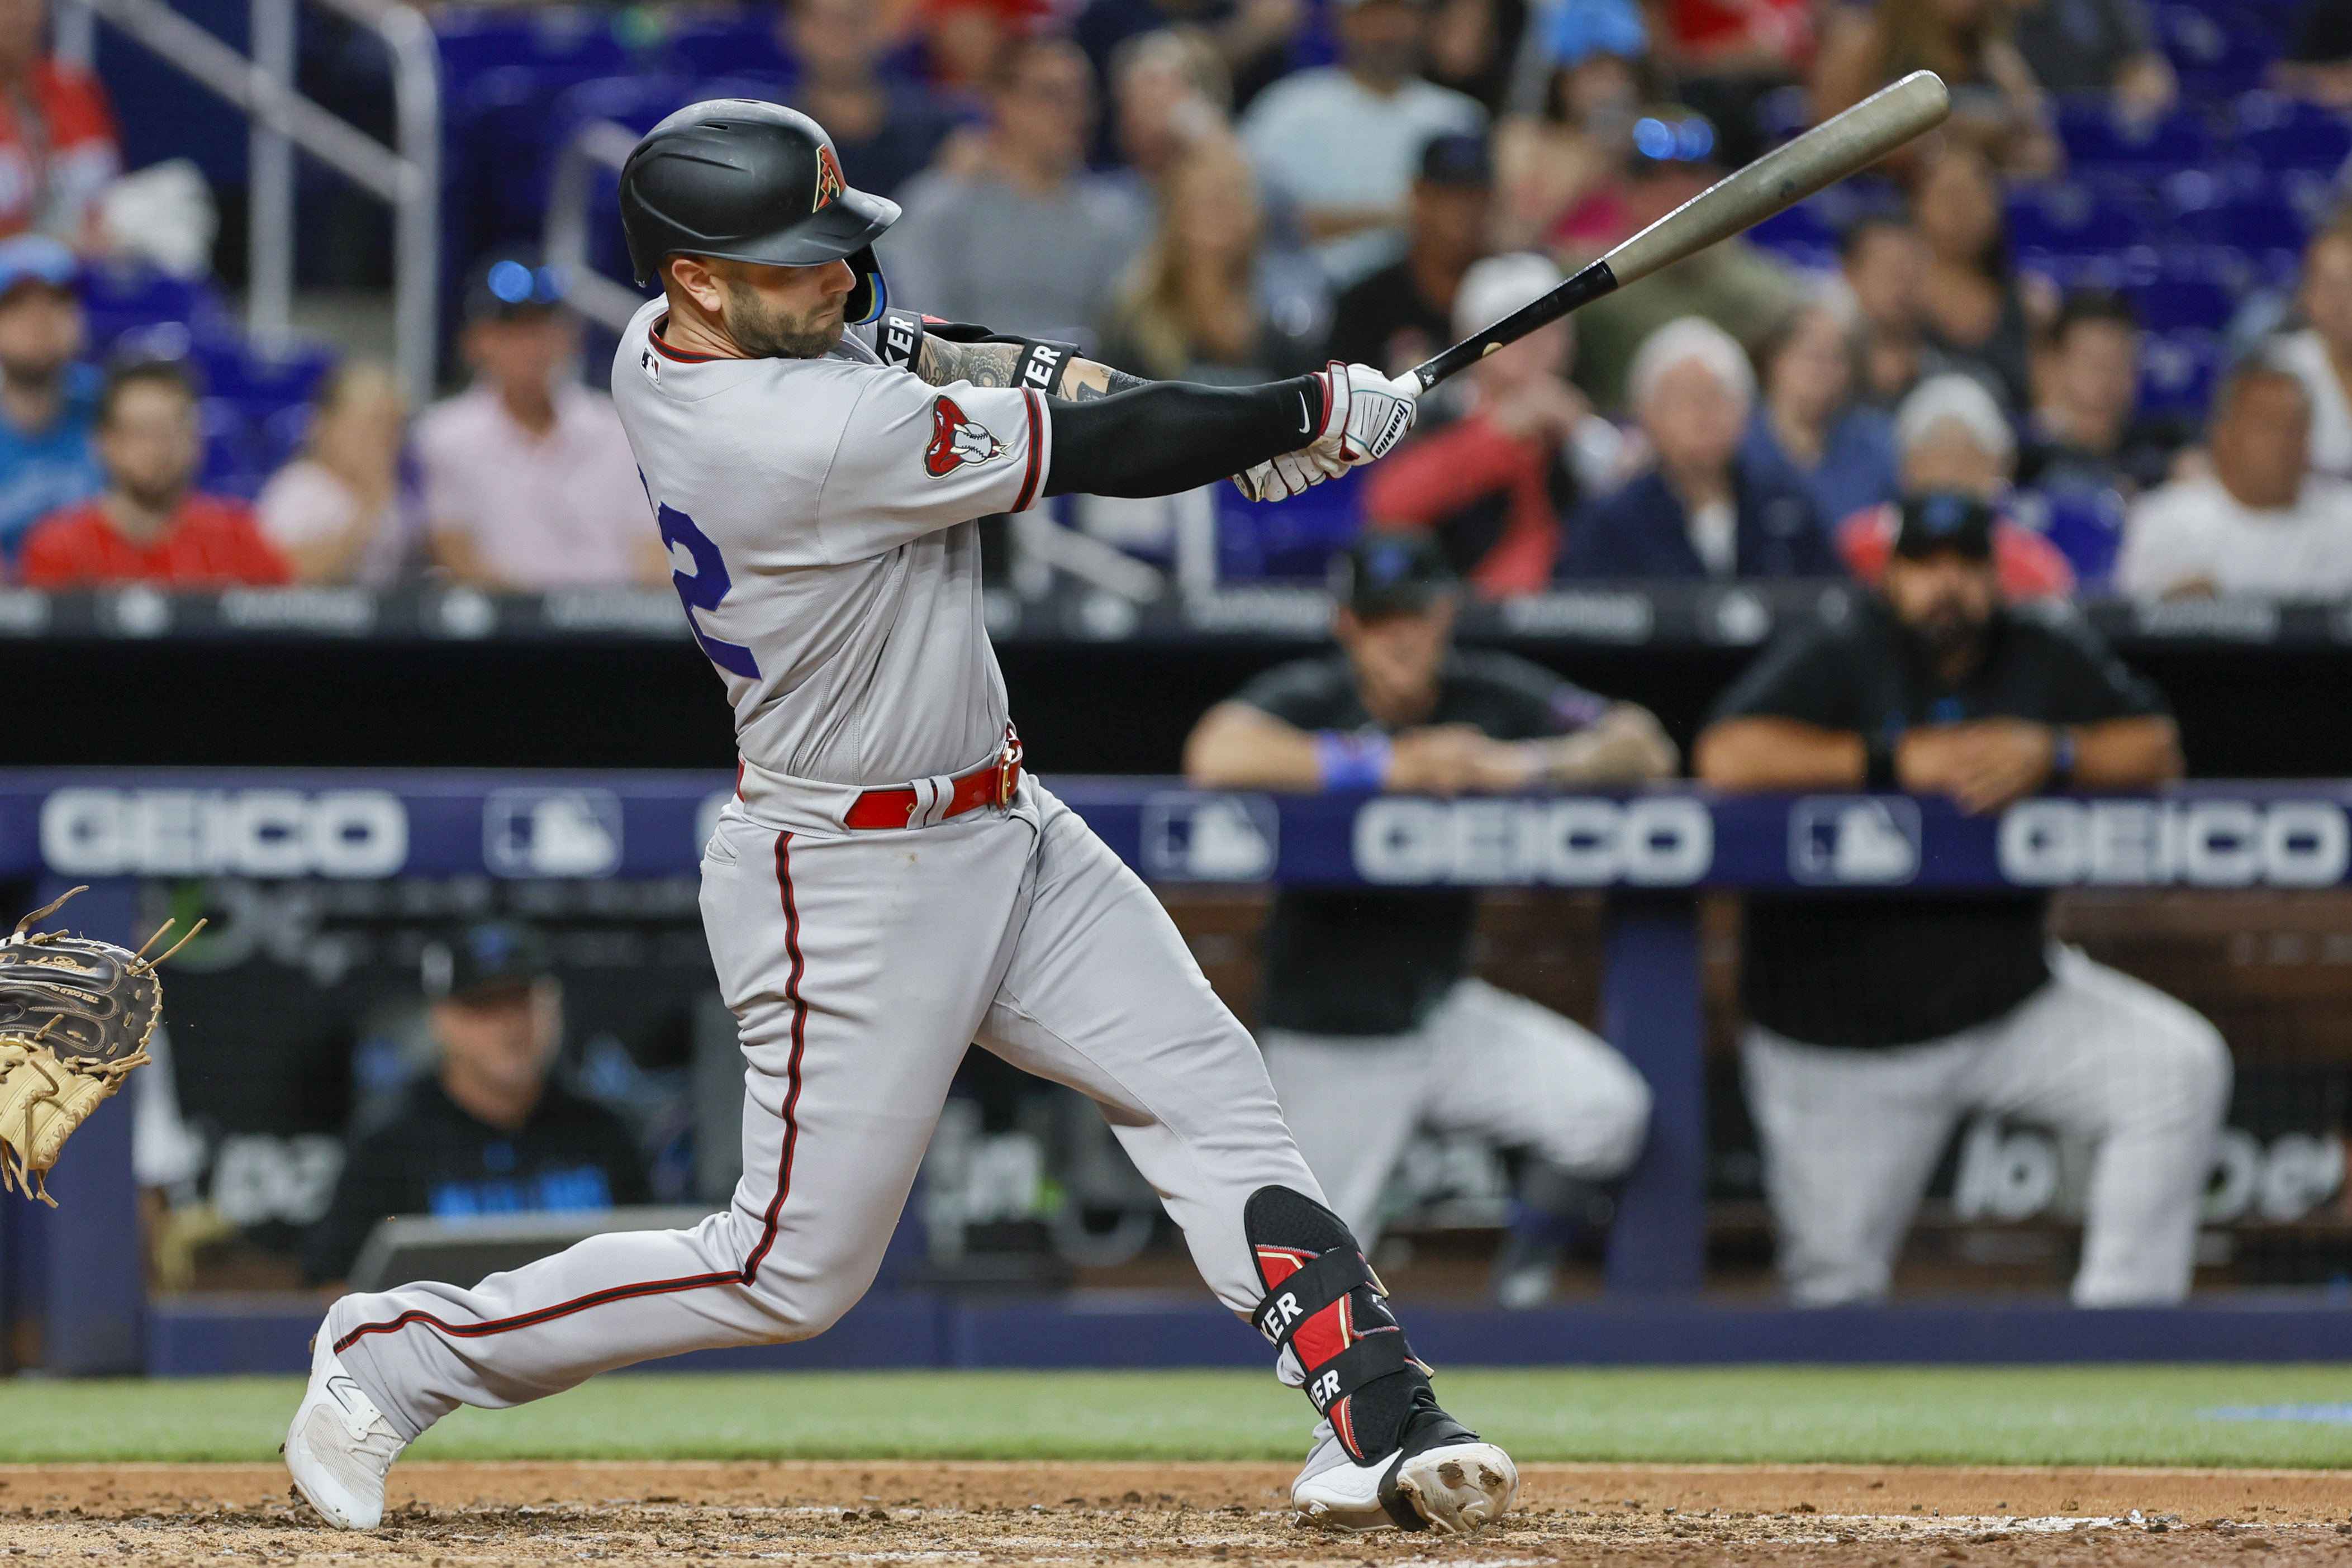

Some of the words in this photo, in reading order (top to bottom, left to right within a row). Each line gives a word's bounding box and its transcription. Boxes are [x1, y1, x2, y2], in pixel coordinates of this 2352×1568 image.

[638, 463, 762, 680] 2
[39, 786, 409, 877] GEICO
[1351, 797, 1714, 886] GEICO
[1999, 799, 2348, 886] GEICO
